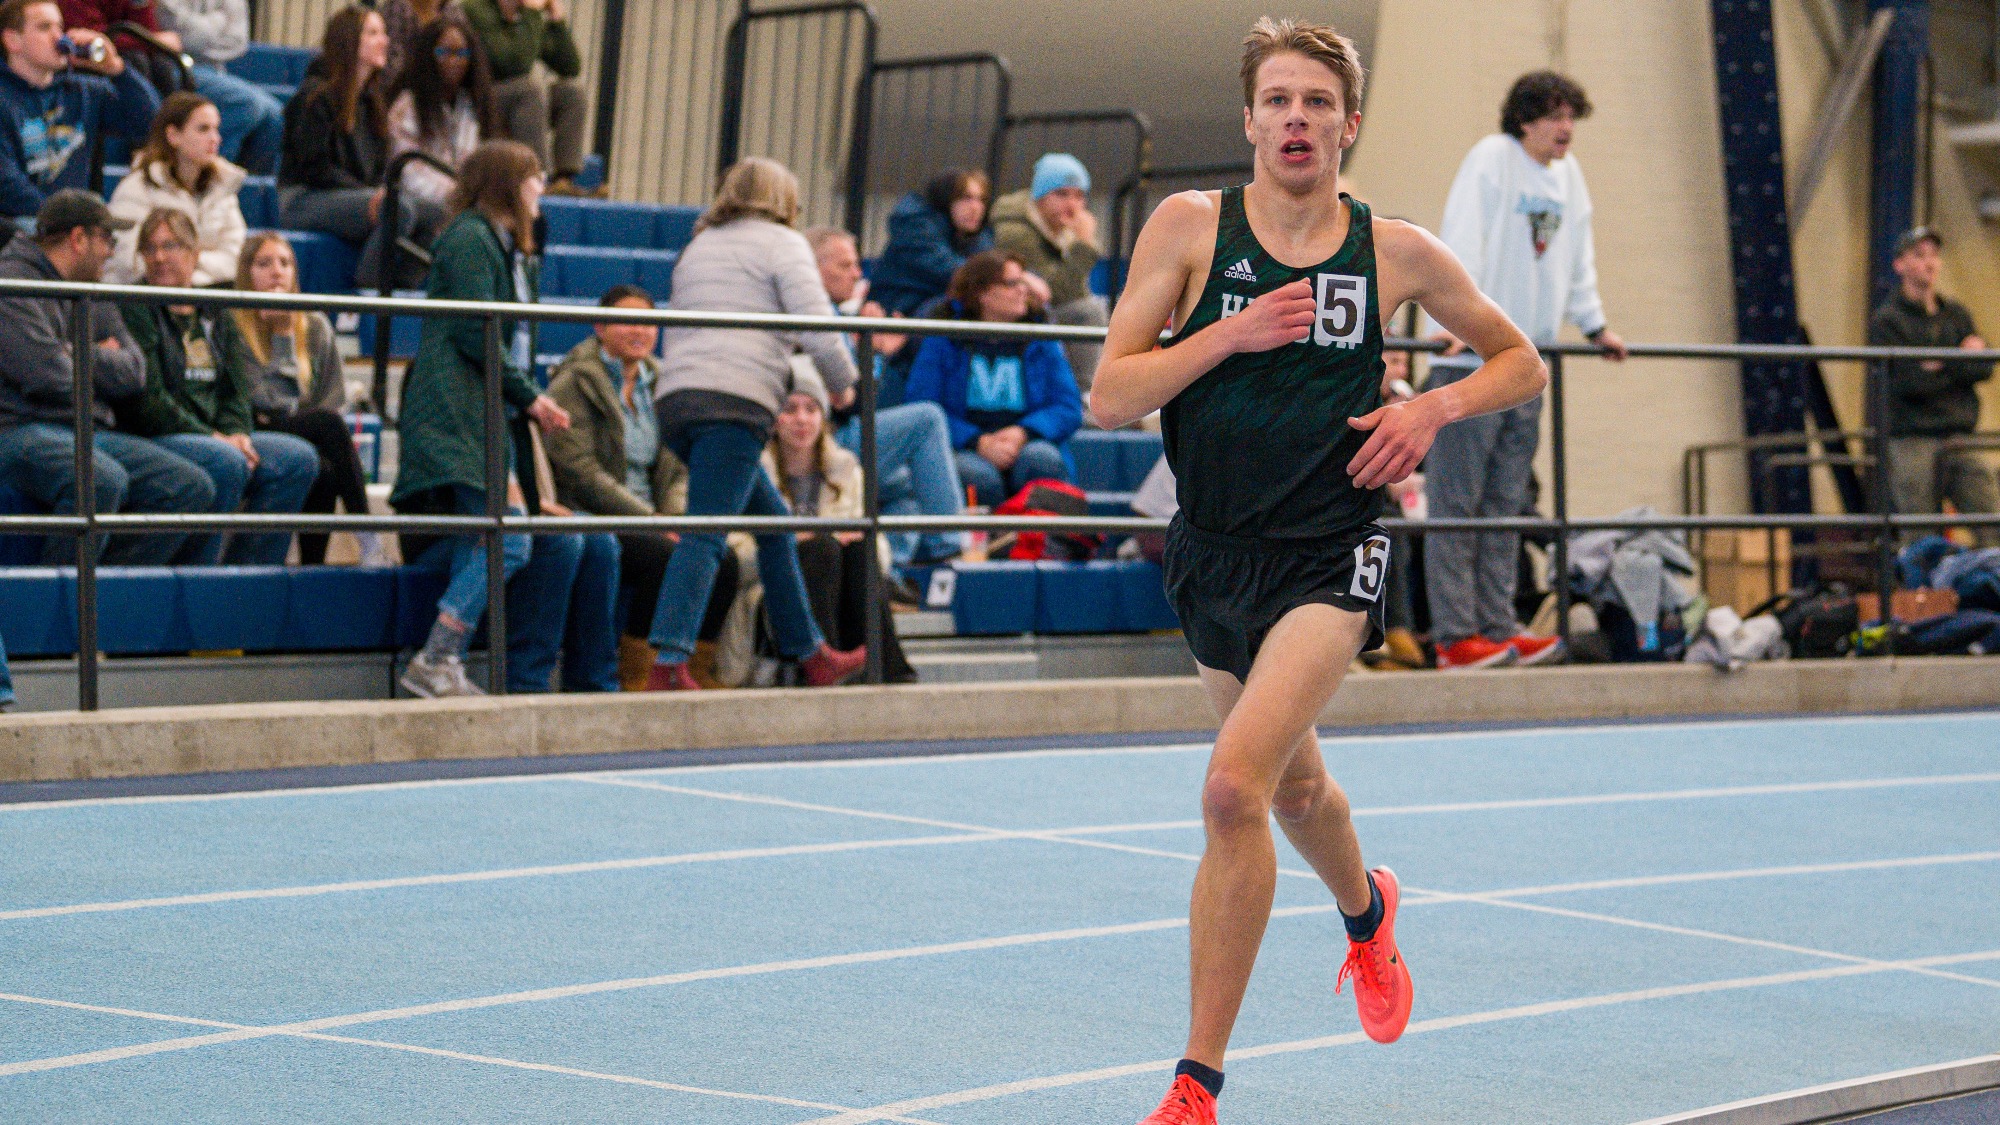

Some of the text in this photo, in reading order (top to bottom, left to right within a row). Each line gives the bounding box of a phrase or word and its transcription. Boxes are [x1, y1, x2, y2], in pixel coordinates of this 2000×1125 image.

[1224, 268, 1257, 283] adidas
[1321, 278, 1358, 338] 5
[968, 354, 1023, 411] M
[1359, 539, 1387, 596] 5
